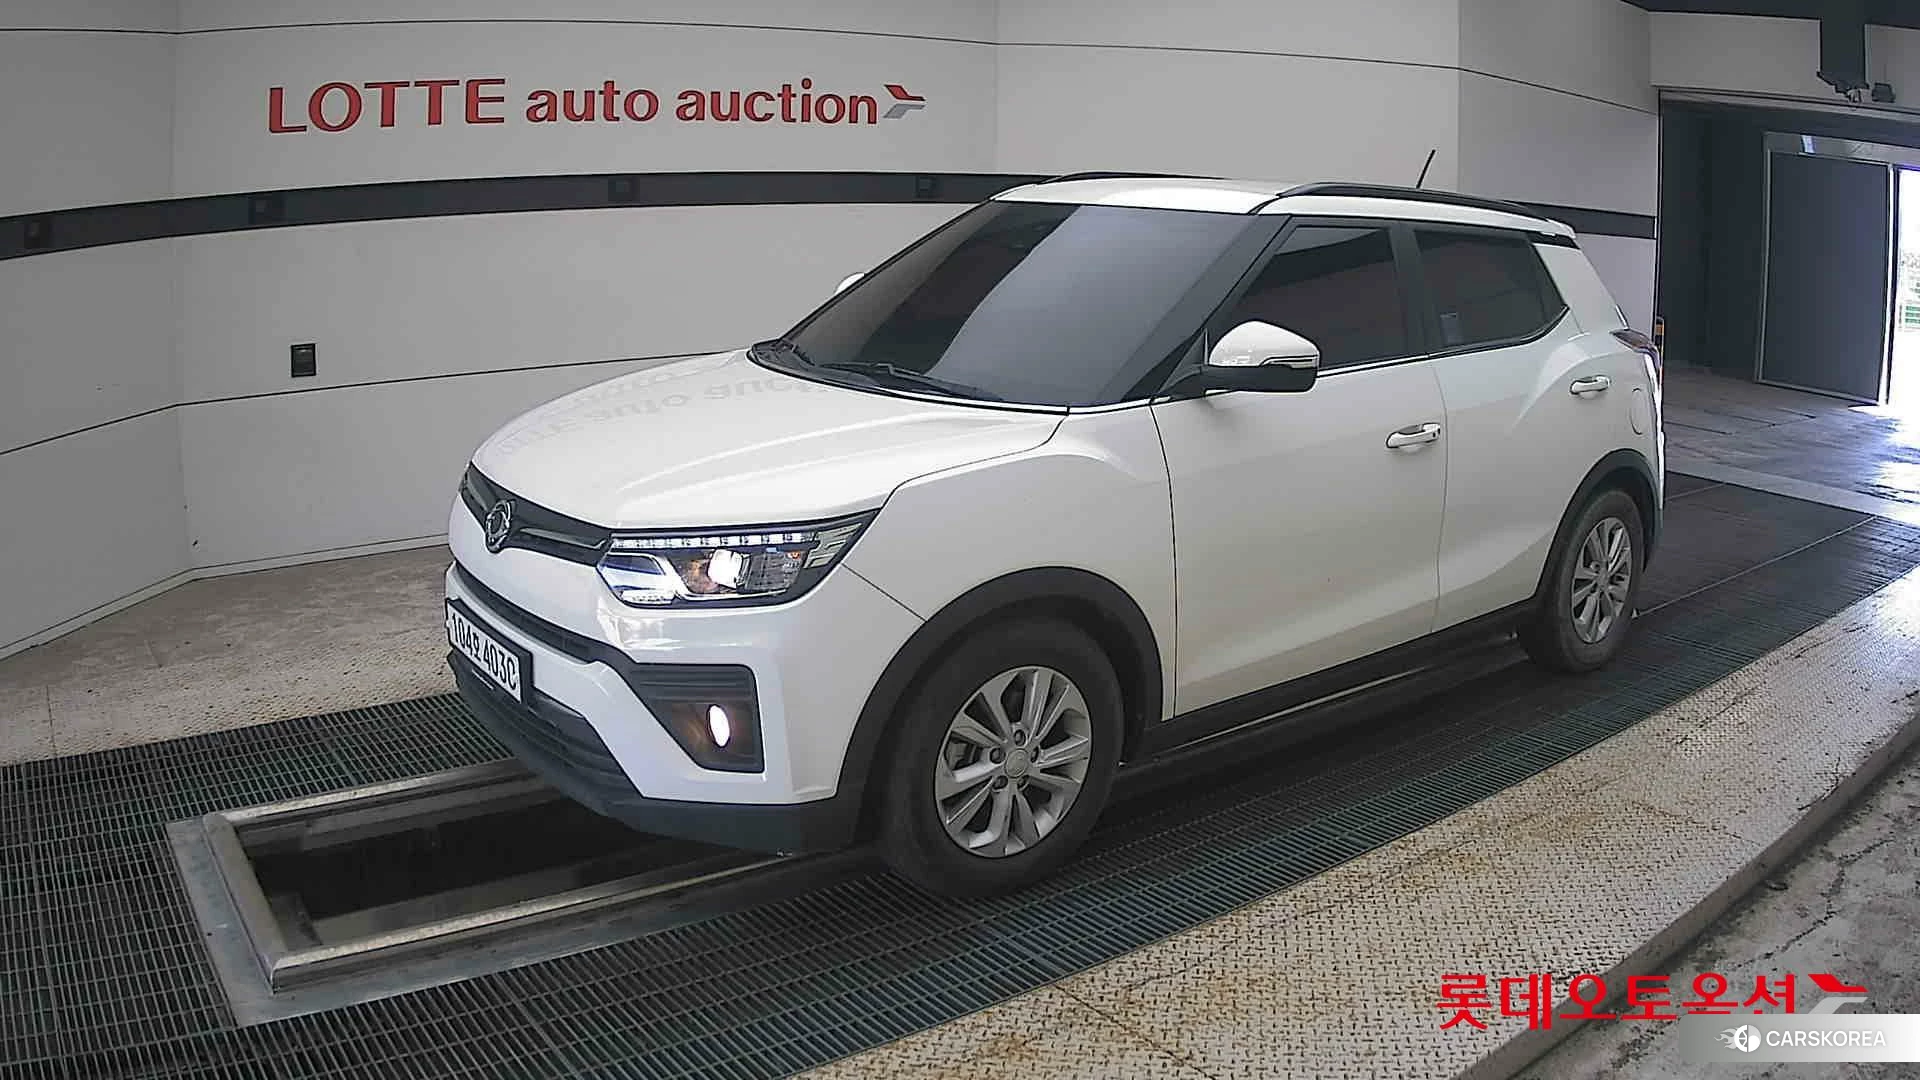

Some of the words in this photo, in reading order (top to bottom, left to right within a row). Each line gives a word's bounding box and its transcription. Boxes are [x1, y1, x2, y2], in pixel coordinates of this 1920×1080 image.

[268, 79, 505, 133] LOTTE
[526, 80, 659, 123] auto
[675, 78, 878, 124] auction
